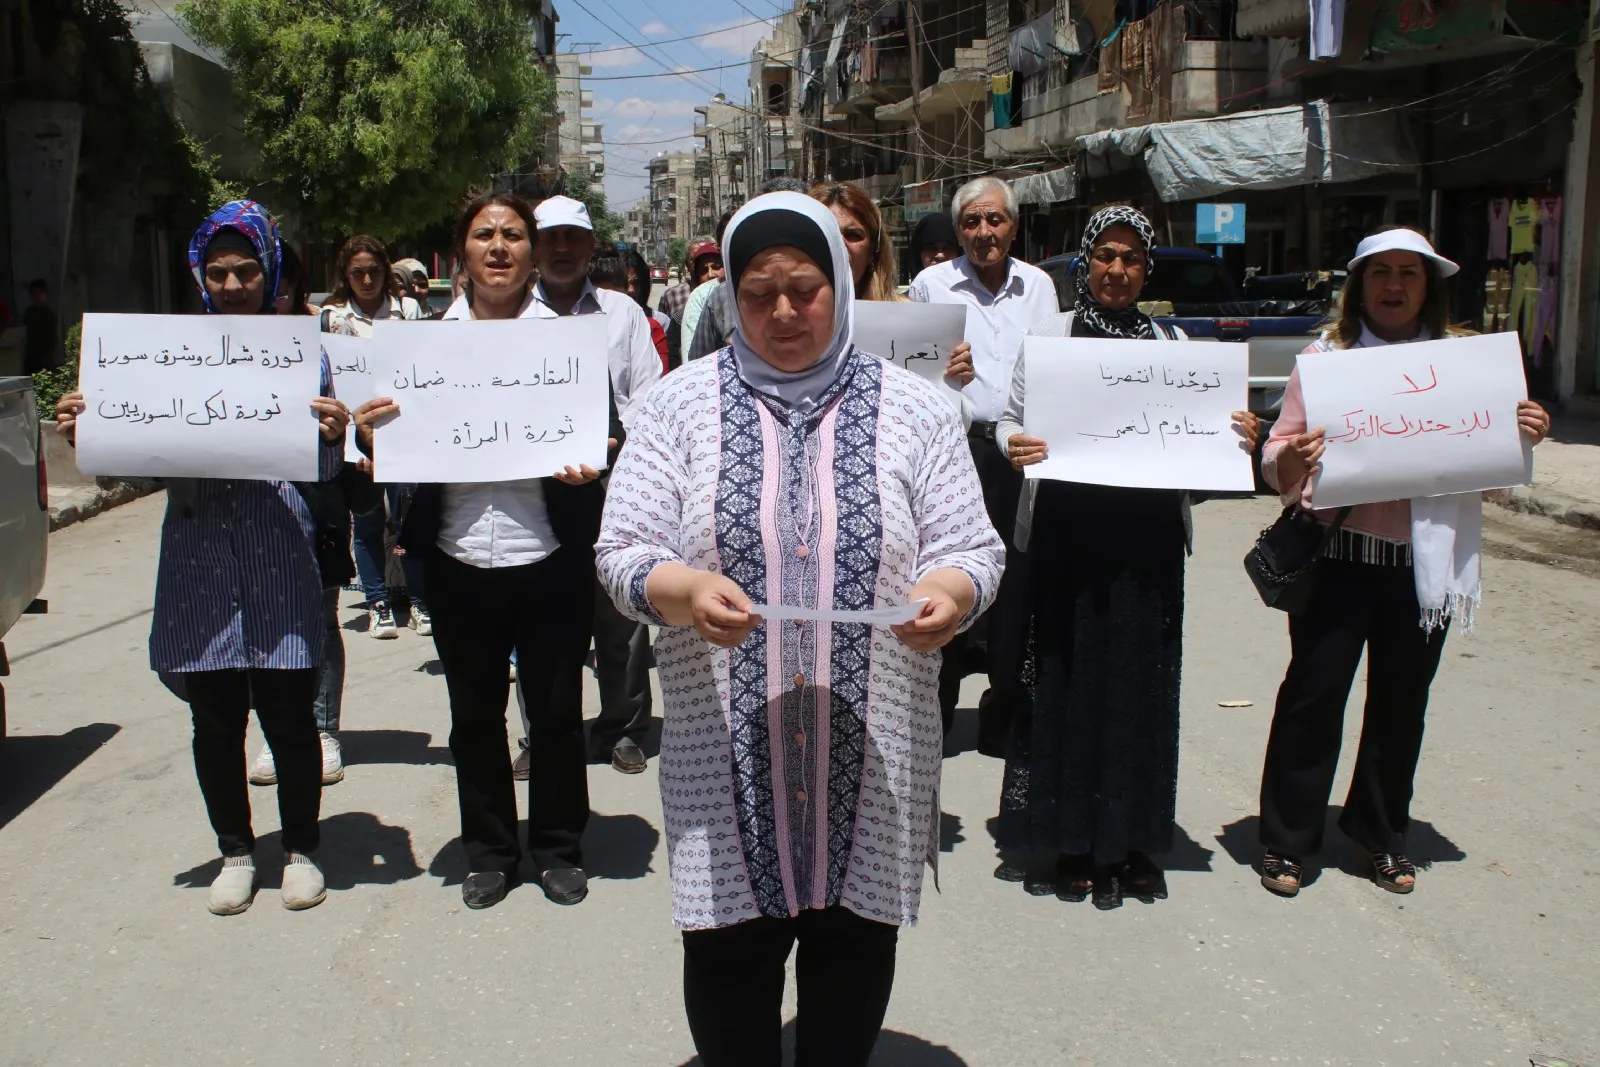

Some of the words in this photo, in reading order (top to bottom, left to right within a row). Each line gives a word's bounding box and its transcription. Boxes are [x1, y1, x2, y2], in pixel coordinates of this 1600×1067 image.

[1214, 203, 1234, 233] P
[98, 336, 148, 368] سوريا
[154, 344, 203, 366] وشرق
[205, 334, 254, 366] شمال
[261, 337, 303, 368] ثورة
[904, 344, 939, 370] نعم
[393, 363, 445, 390] ضمان
[491, 356, 579, 387] المقاومة
[1098, 361, 1154, 387] انتصرنا
[1391, 364, 1437, 396] لا
[98, 396, 184, 425] السوريين
[185, 389, 228, 426] لكل
[235, 393, 282, 421] ثورة
[524, 415, 574, 443] ثورة
[1077, 411, 1151, 442] لنحمي
[1158, 415, 1220, 450] سنقاوم
[1323, 409, 1380, 443] التركي
